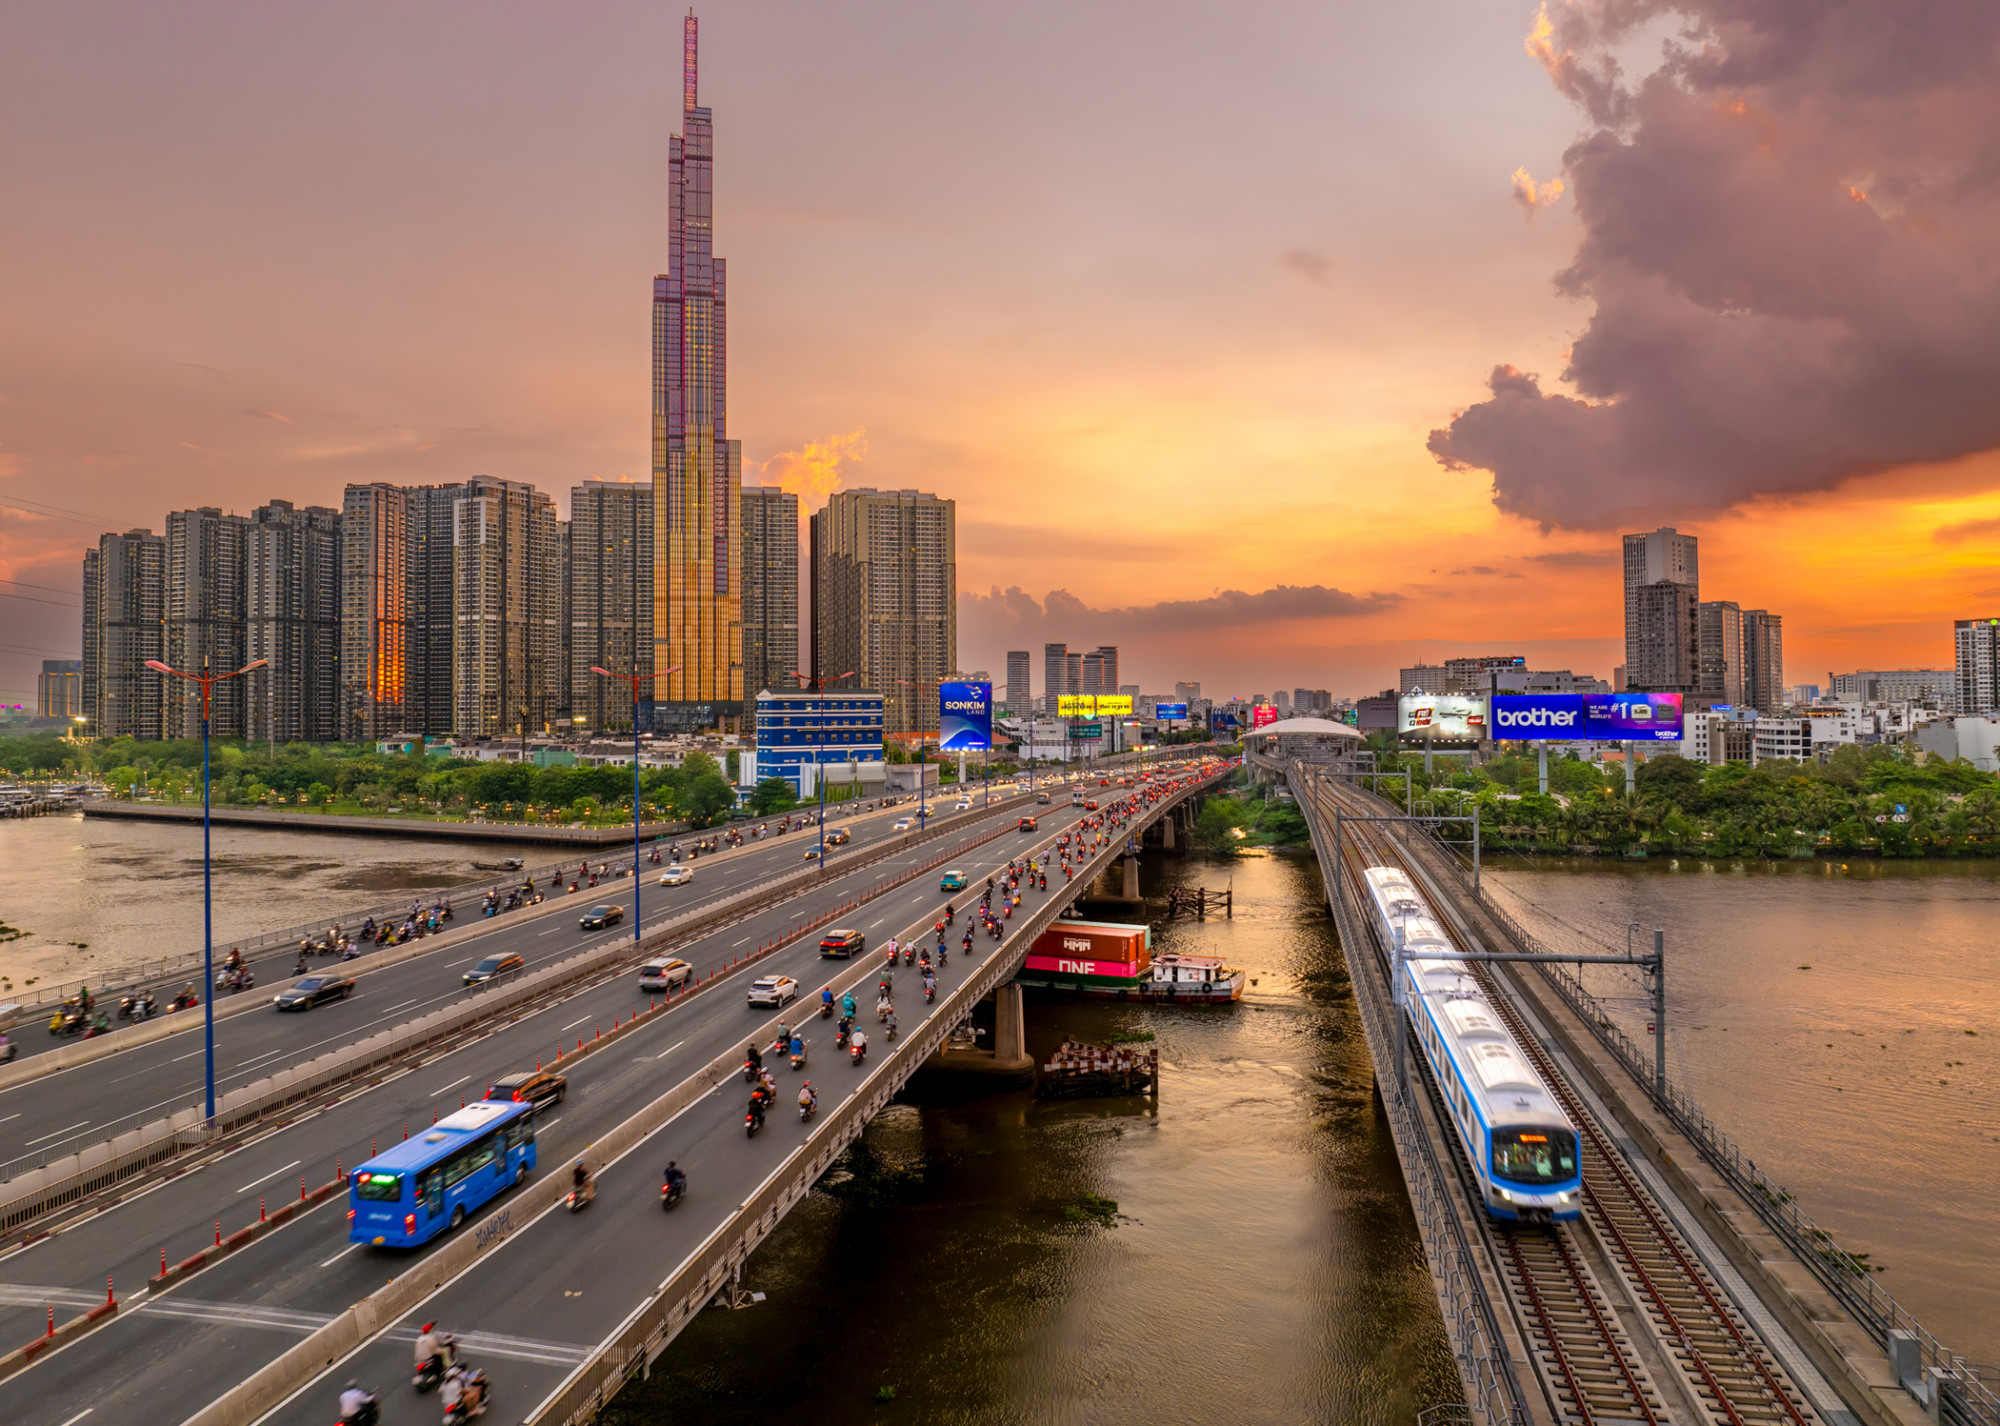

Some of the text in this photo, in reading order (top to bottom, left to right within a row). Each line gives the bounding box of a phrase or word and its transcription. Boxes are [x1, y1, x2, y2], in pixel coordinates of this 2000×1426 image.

[945, 701, 985, 710] SONKIM
[1497, 708, 1577, 727] brother
[1064, 938, 1091, 952] HMM
